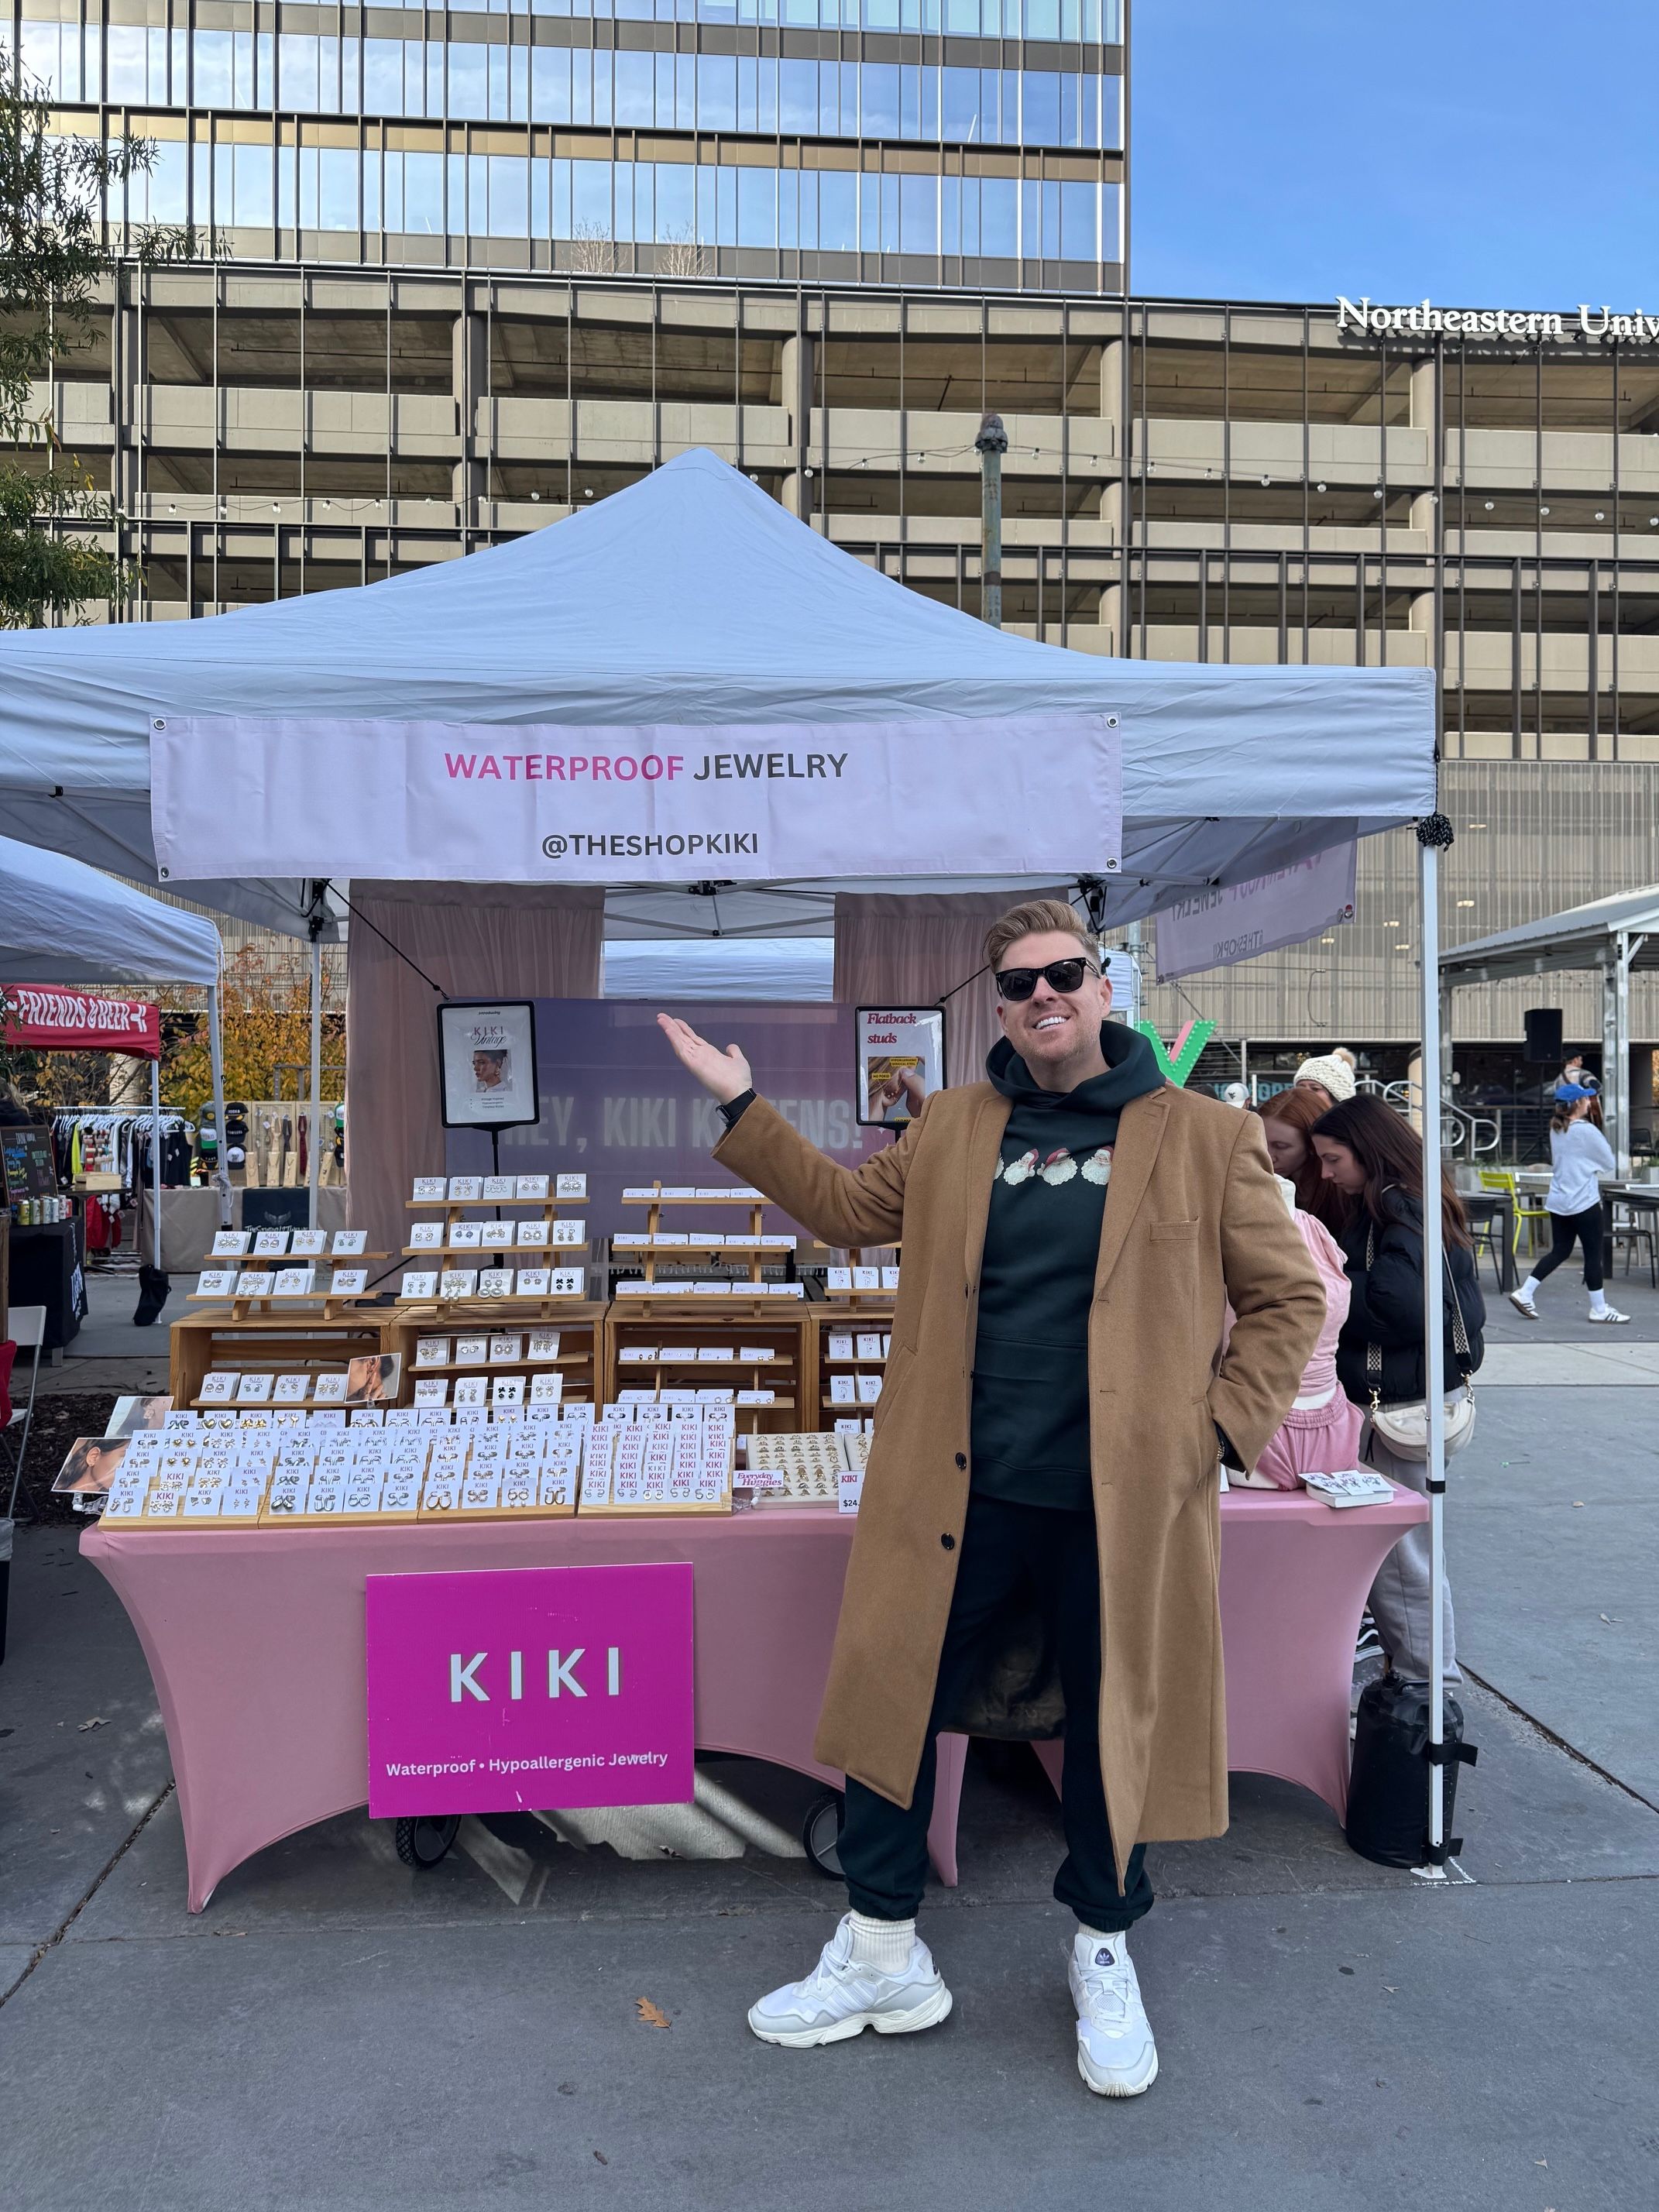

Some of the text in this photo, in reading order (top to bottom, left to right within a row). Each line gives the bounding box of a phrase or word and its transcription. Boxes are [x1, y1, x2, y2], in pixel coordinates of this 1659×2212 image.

[1335, 296, 1659, 337] Northeastern Univ
[444, 752, 848, 781] WATERPROOF JEWELRY
[541, 833, 759, 859] @THESHOPKIKI
[19, 990, 87, 1028] FRIENDS
[98, 999, 130, 1030] BEER
[867, 1013, 917, 1024] Flatback
[471, 1033, 507, 1047] Vintage
[474, 1026, 503, 1035] KIKI
[867, 1032, 897, 1044] studs
[603, 1097, 675, 1146] KIKI
[841, 1475, 858, 1483] KIKI
[450, 1647, 620, 1702] KIKI
[386, 1751, 668, 1778] Waterproof Hypoallergenic Jewelry
